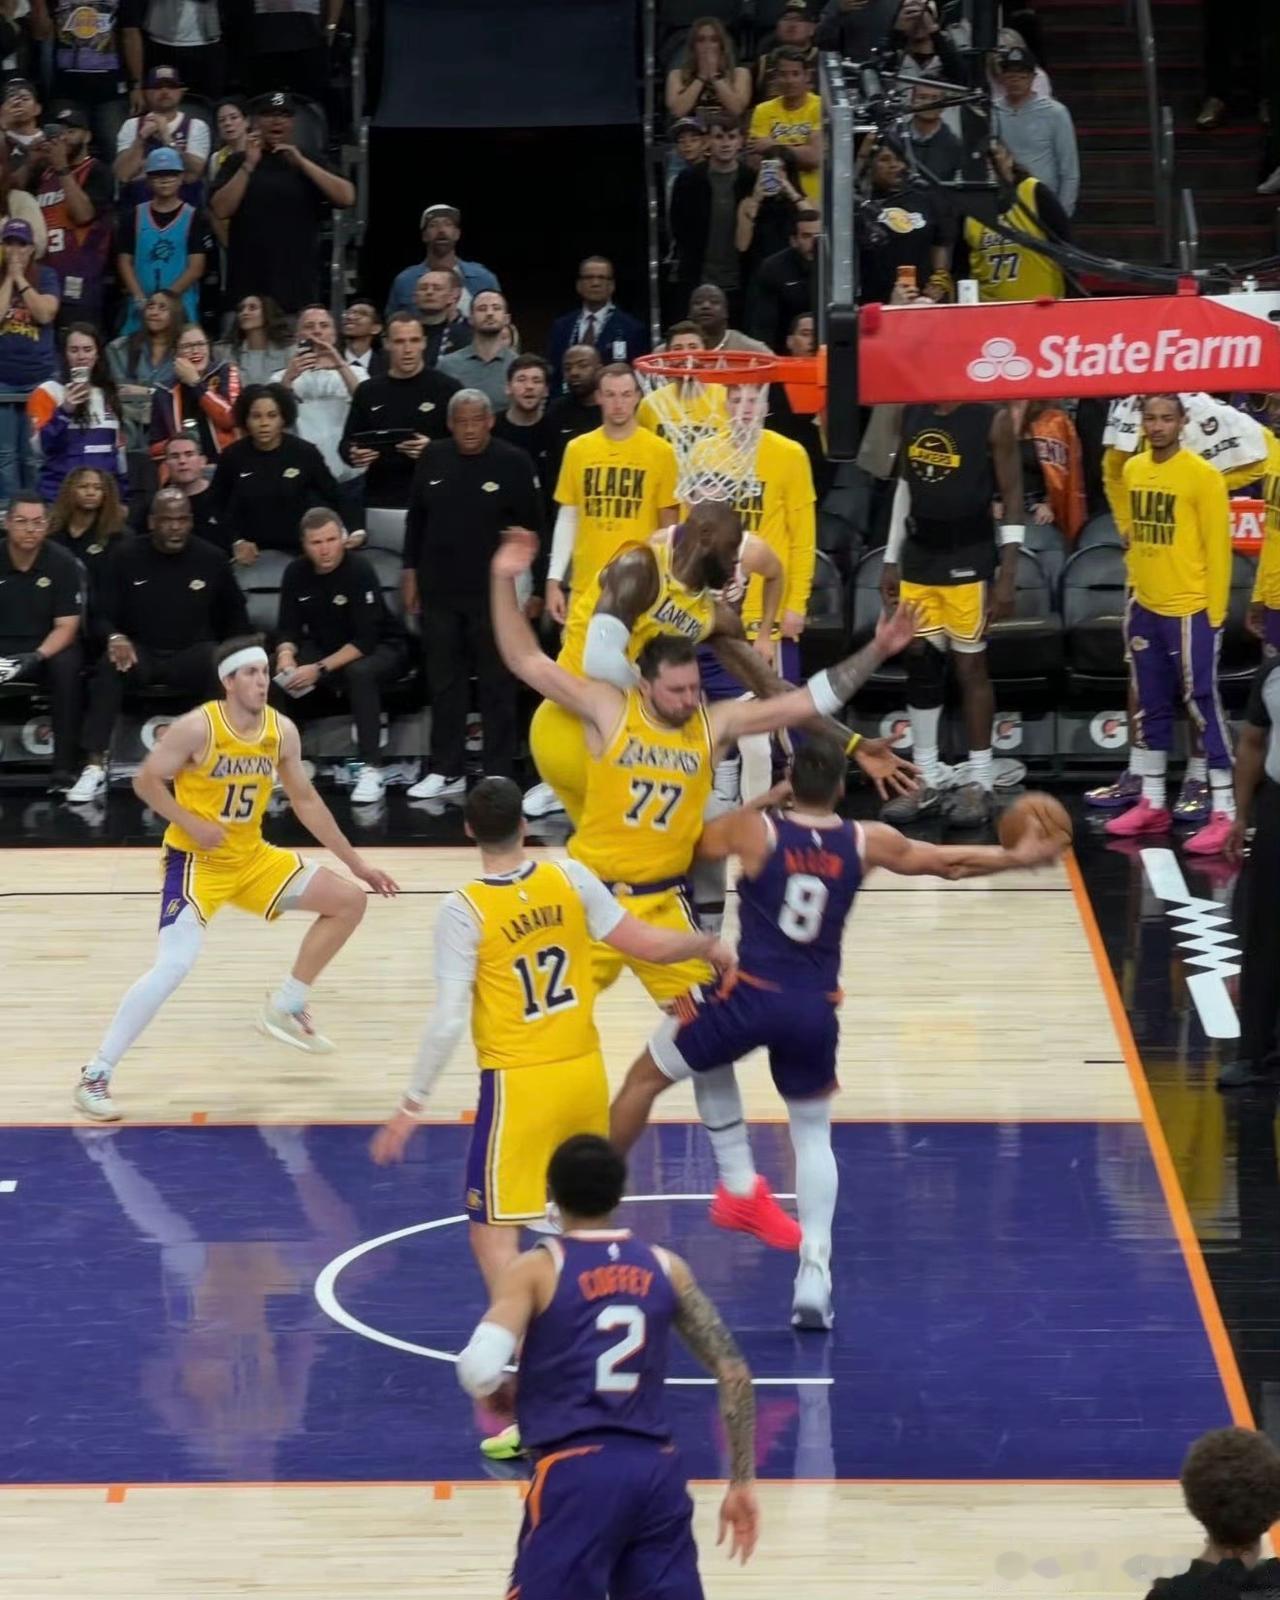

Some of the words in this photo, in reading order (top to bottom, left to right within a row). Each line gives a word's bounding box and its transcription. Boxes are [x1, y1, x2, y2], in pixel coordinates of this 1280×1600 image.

[989, 252, 1019, 283] 77
[584, 466, 646, 498] BLACK
[219, 783, 259, 820] 15
[624, 778, 684, 828] 77
[777, 872, 829, 944] 8
[512, 945, 577, 1020] 12
[577, 1264, 655, 1302] COFFEY
[595, 1304, 646, 1392] 2
